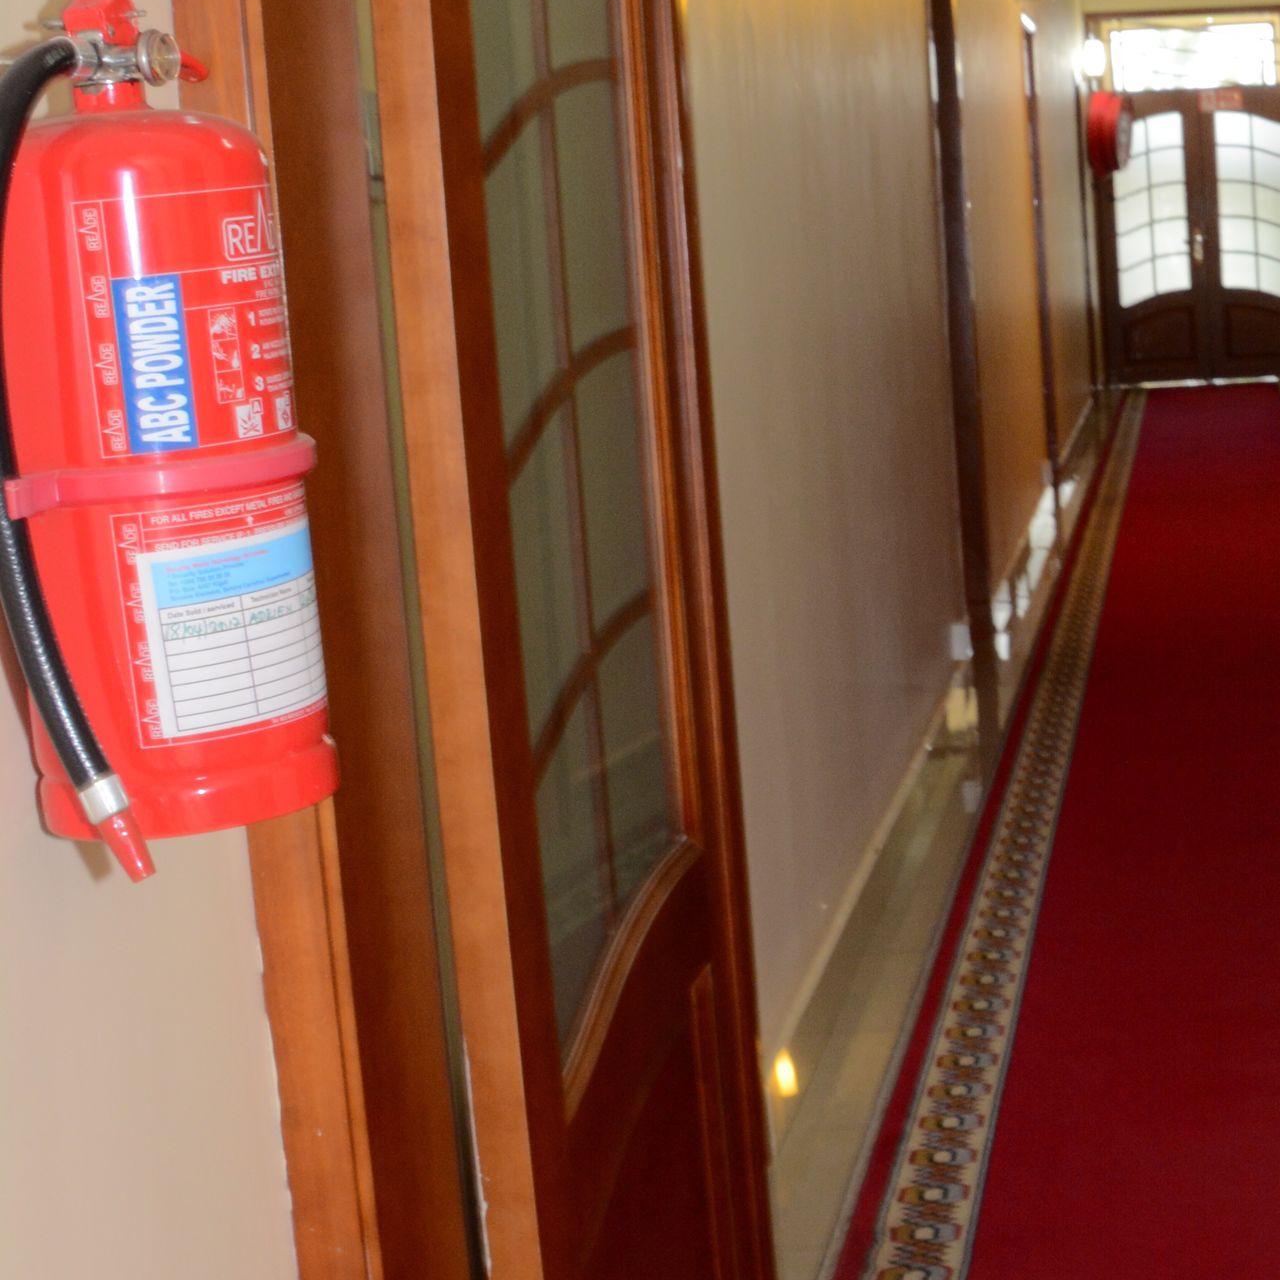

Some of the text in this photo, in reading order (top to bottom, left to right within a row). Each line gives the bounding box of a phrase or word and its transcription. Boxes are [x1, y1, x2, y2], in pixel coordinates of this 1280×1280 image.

[221, 267, 257, 285] FIRE
[248, 311, 256, 326] 1
[251, 343, 261, 359] 2
[125, 281, 192, 444] ABC POWDER
[255, 376, 265, 391] 3
[151, 513, 171, 526] FOR
[172, 512, 188, 523] ALL
[189, 508, 215, 520] FIRES
[215, 504, 245, 517] EXCEPT
